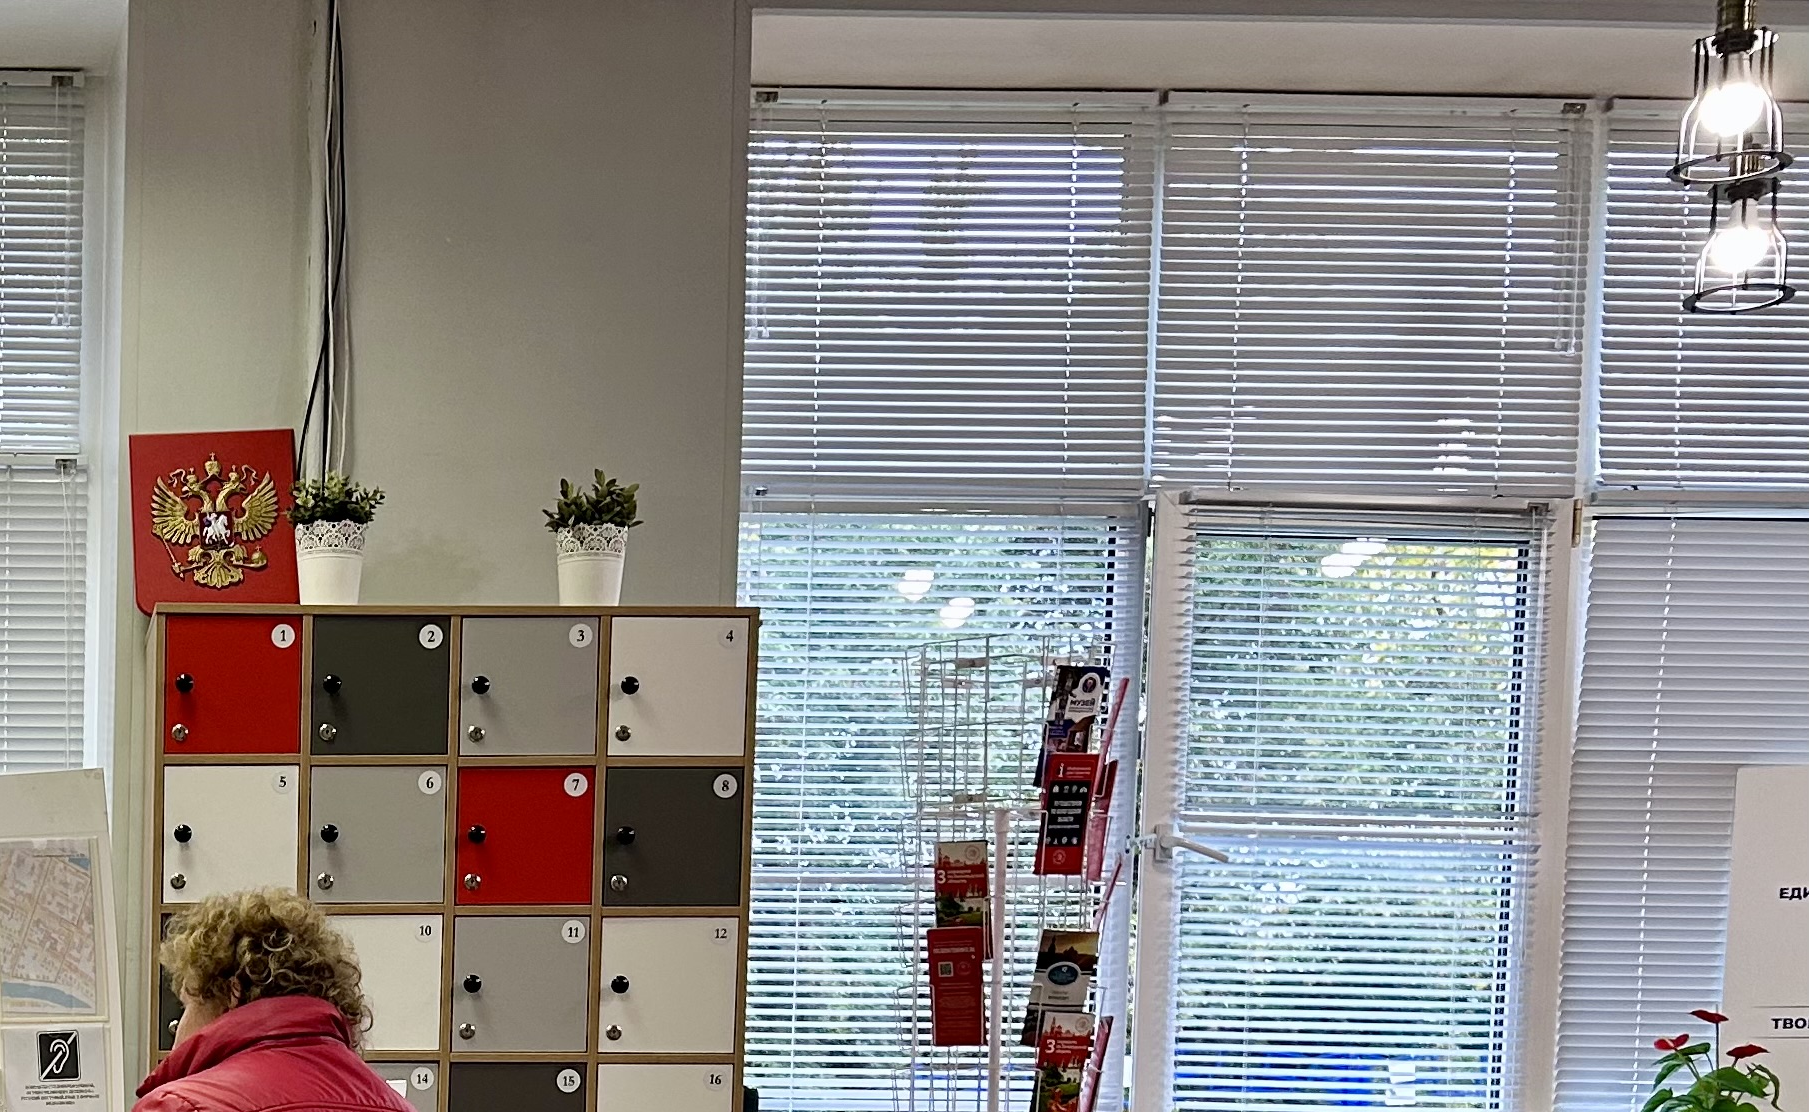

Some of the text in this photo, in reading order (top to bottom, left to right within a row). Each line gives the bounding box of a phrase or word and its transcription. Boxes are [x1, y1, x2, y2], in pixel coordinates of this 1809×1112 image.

[280, 629, 287, 642] 1
[427, 630, 436, 643] 2
[576, 629, 585, 642] 3
[725, 629, 734, 643] 4
[279, 775, 287, 788] 5
[426, 776, 434, 789] 6
[571, 778, 580, 791] 7
[721, 779, 730, 792] 8
[419, 925, 432, 936] 10
[568, 926, 579, 938] 11
[715, 928, 728, 939] 12
[1770, 1017, 1809, 1030] ТВО
[417, 1073, 428, 1085] 14
[563, 1075, 575, 1087] 15
[709, 1073, 722, 1085] 16
